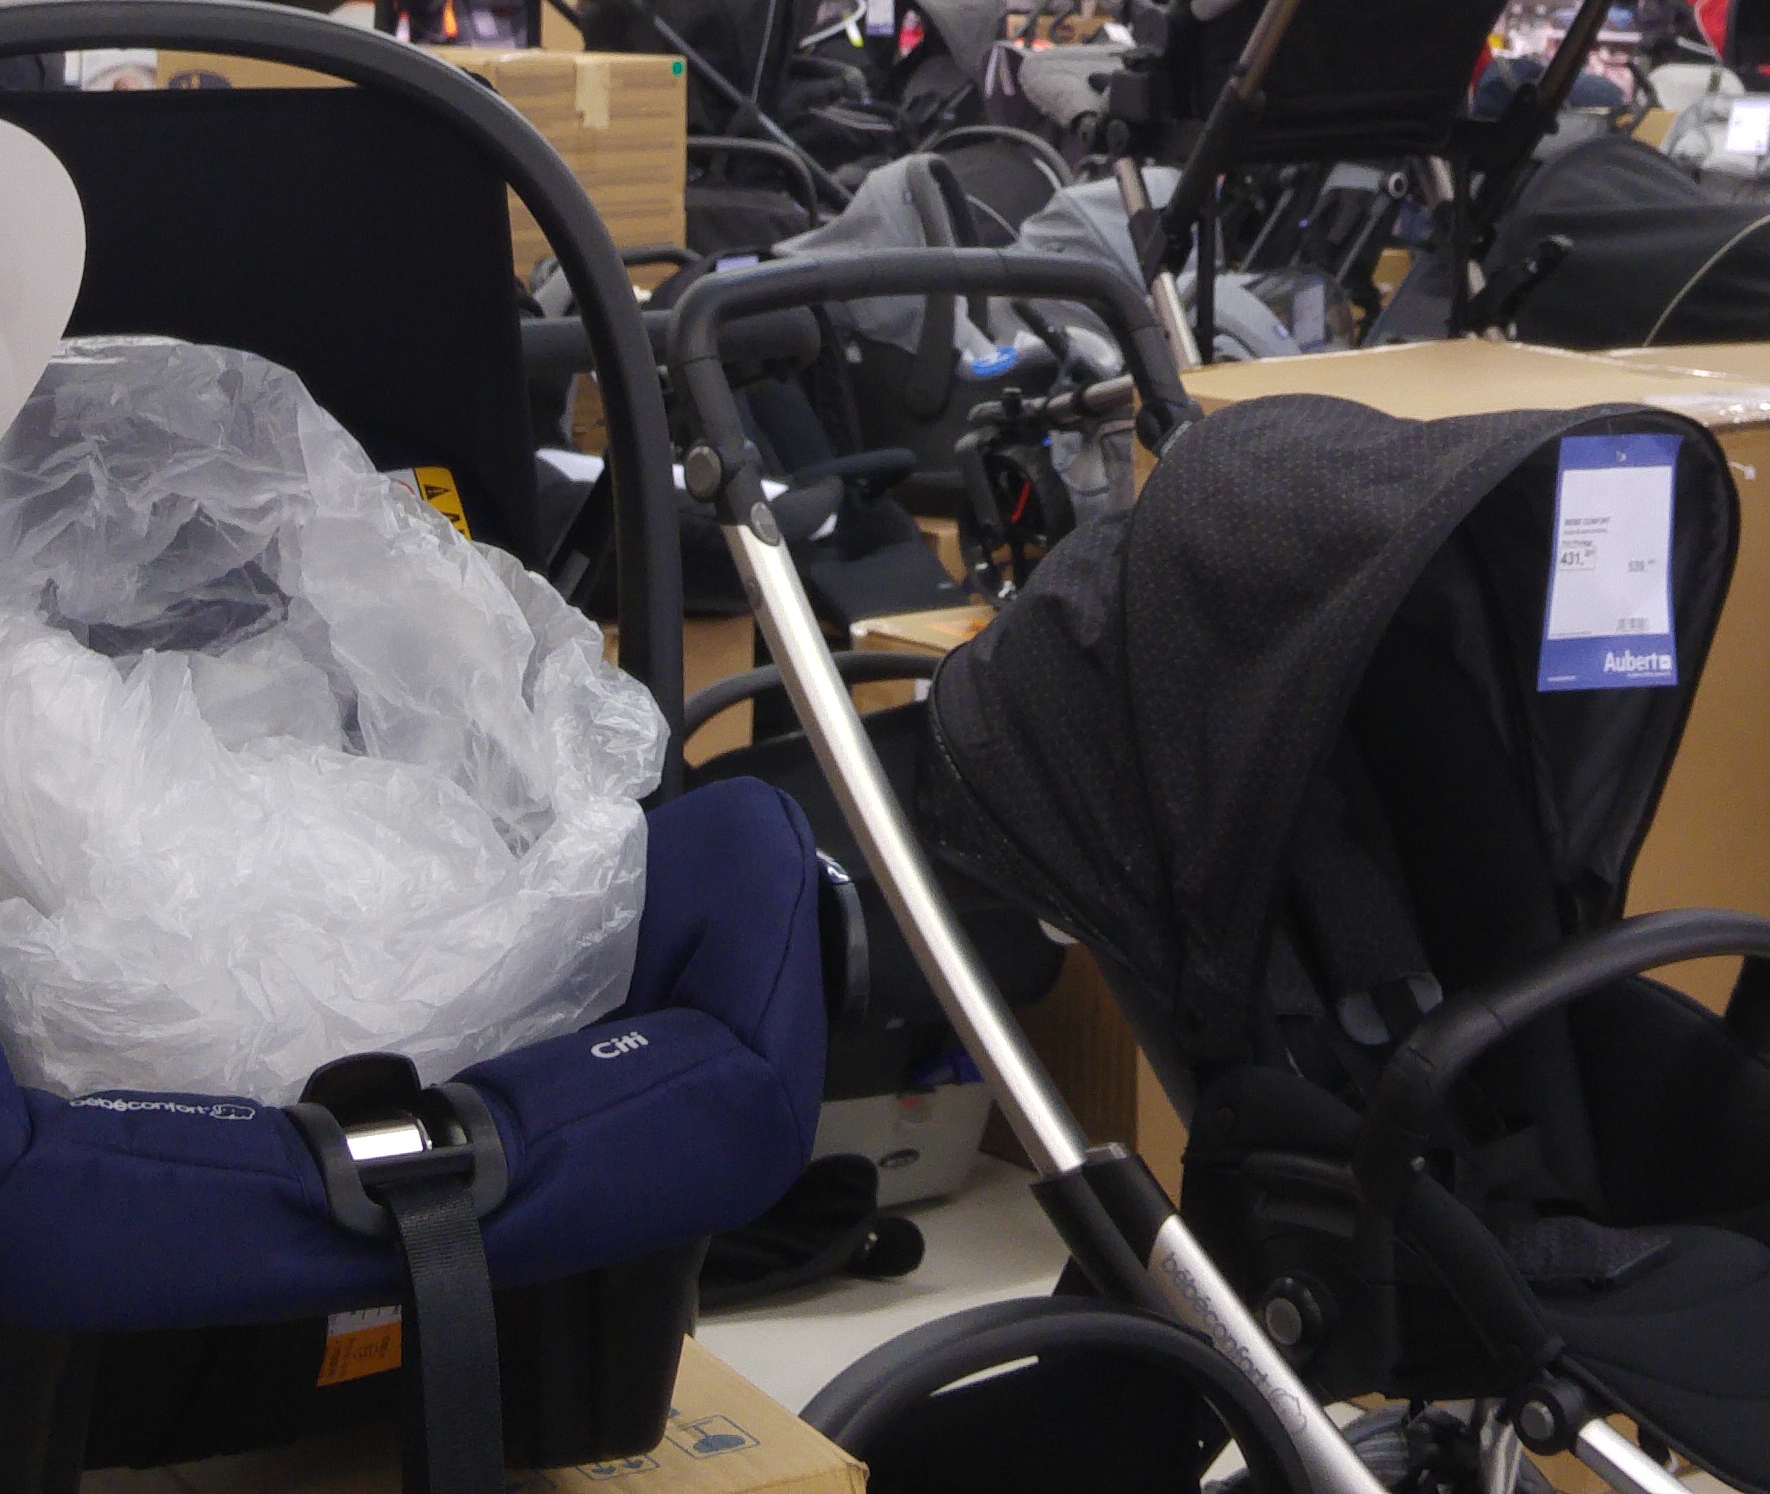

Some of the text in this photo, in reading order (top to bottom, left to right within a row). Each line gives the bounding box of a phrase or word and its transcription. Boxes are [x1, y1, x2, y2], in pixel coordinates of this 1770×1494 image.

[1603, 649, 1659, 674] Aubert
[590, 1031, 649, 1059] Citi
[1161, 1251, 1269, 1388] bébéconfort
